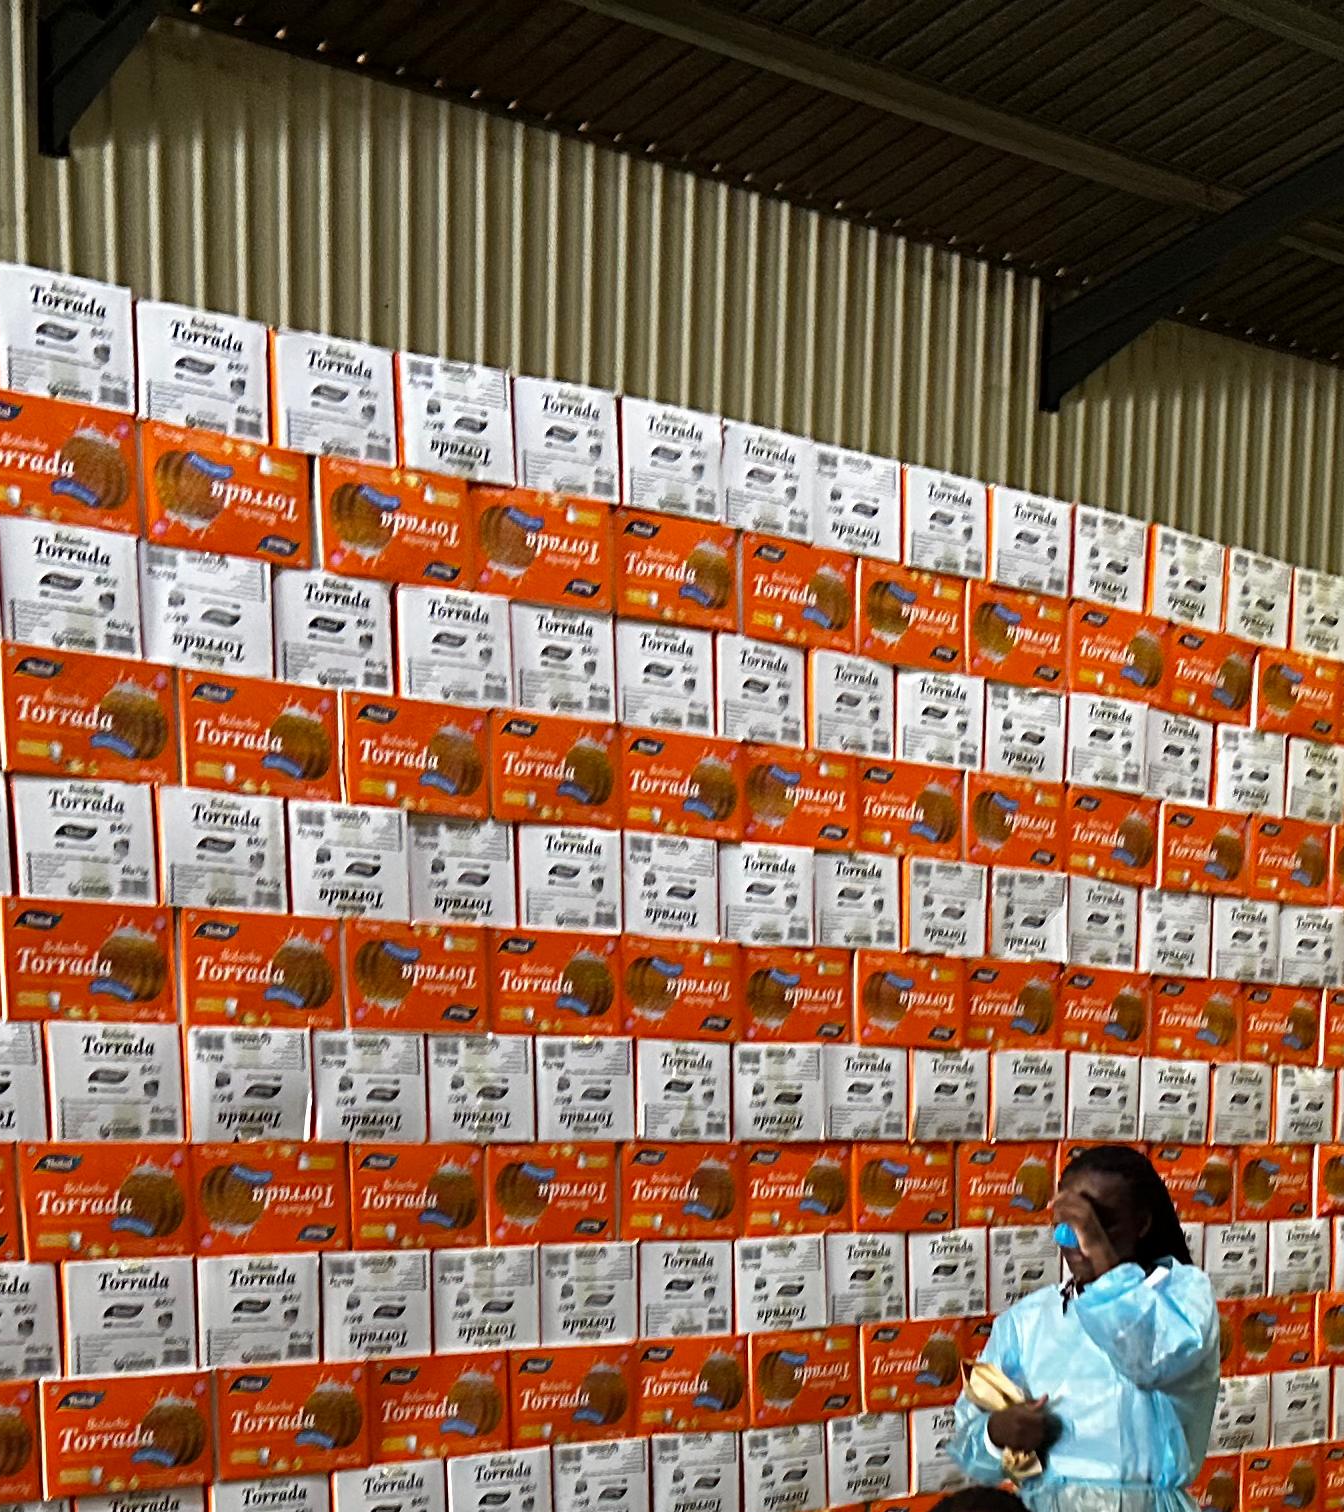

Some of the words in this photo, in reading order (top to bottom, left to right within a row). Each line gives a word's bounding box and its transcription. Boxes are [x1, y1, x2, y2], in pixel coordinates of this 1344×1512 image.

[30, 285, 107, 319] Torrada
[170, 321, 244, 353] Torrada
[307, 351, 374, 379] Torrada
[210, 481, 297, 520] Torrada
[379, 511, 461, 545] Torrada
[33, 536, 113, 567] Torrada
[303, 582, 371, 609] Torrada
[172, 634, 245, 661] Torrada
[16, 696, 114, 733] Torrada
[193, 720, 284, 754] Torrada
[359, 740, 440, 770] Torrada
[47, 789, 126, 814] Torrada
[191, 805, 261, 828] Torrada
[16, 946, 113, 978] Torrada
[195, 955, 285, 984] Torrada
[81, 1036, 155, 1055] Torrada
[36, 1190, 134, 1215] Torrada
[252, 1185, 336, 1208] Torrada
[361, 1186, 438, 1210] Torrada
[97, 1271, 170, 1290] Torrada
[228, 1267, 296, 1288] Torrada
[231, 1407, 316, 1434] Torrada
[58, 1425, 155, 1454] Torrada
[241, 1485, 308, 1507] Torrada
